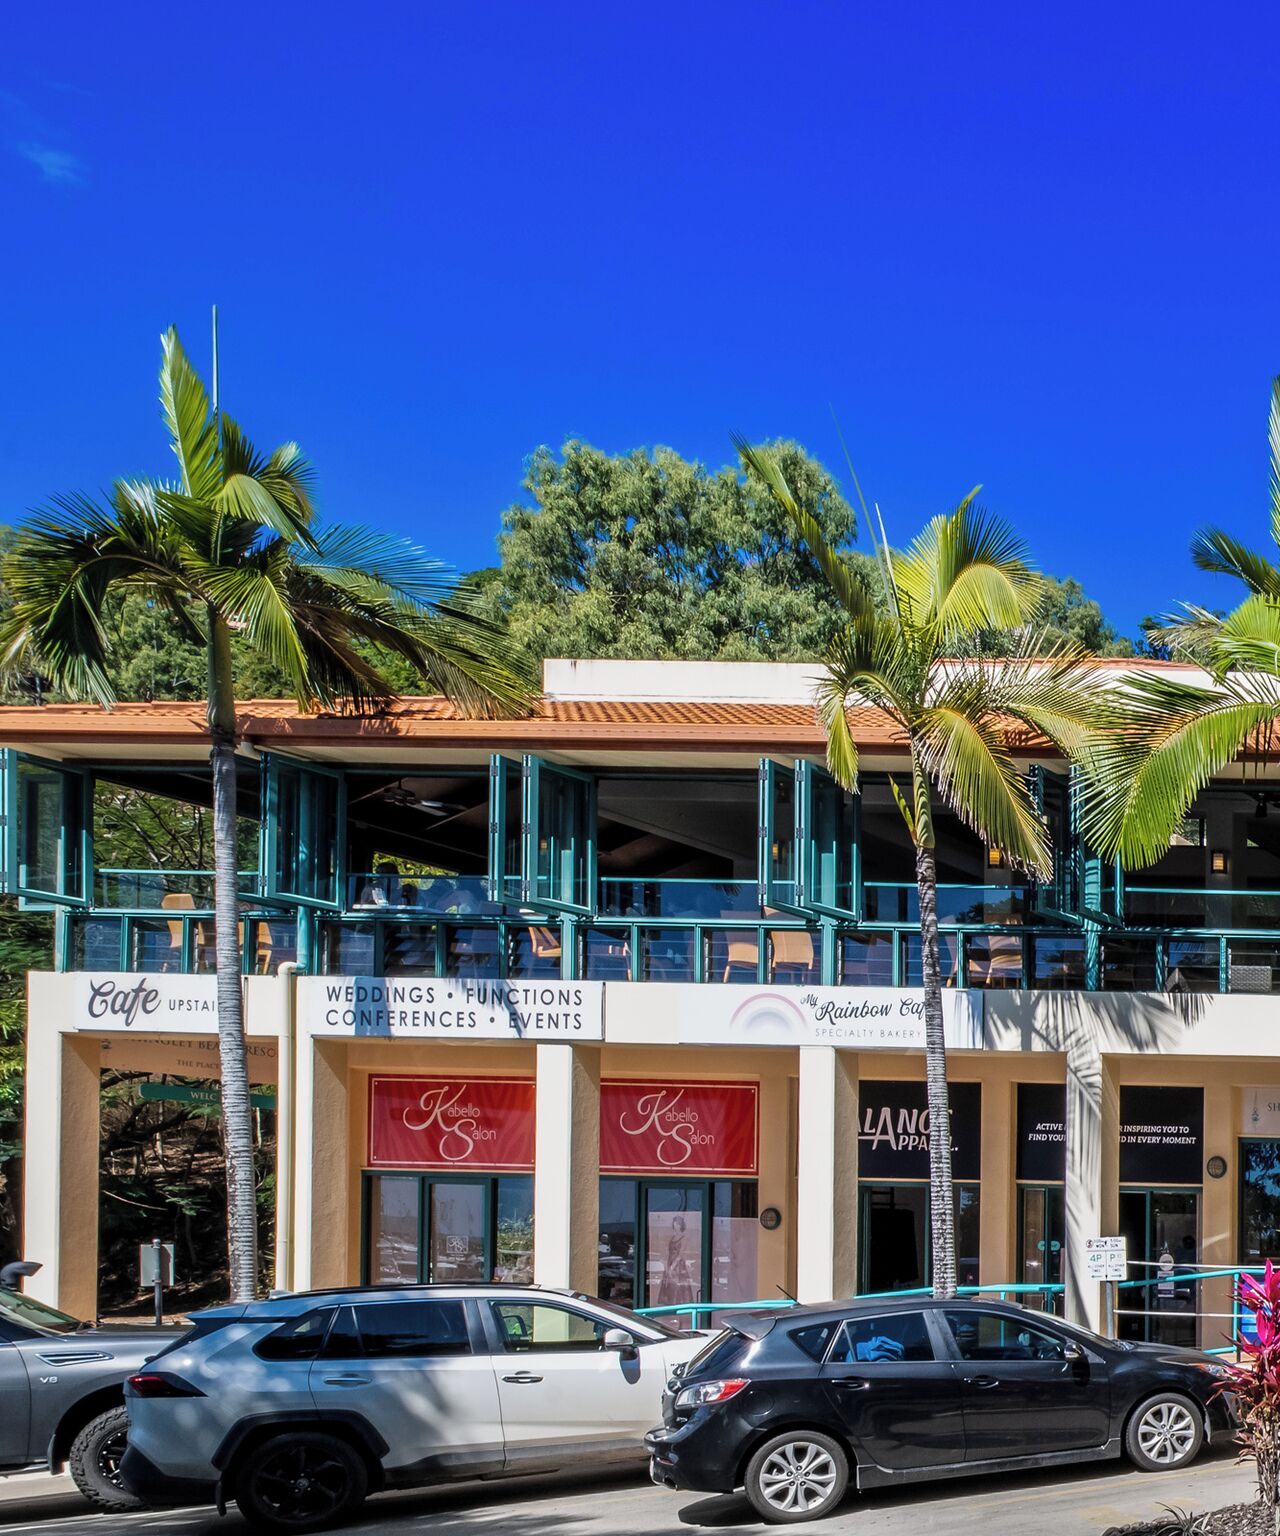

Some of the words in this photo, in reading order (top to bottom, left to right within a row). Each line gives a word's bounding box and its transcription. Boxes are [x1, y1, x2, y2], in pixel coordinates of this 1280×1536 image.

[168, 998, 216, 1012] UPSTAI
[326, 986, 435, 1004] WEDDINGS
[466, 988, 583, 1006] FUNCTIONS
[326, 1009, 477, 1028] CONFERENCES
[508, 1012, 583, 1030] EVENTS
[800, 993, 818, 1009] My
[814, 1000, 892, 1026] Rainbow
[899, 997, 926, 1020] Caf
[815, 1028, 874, 1038] SPECIALTY
[880, 1029, 921, 1039] BAKERY
[190, 1091, 218, 1101] WELC
[403, 1084, 480, 1132] Kabello
[620, 1089, 699, 1136] Kabello
[1036, 1123, 1063, 1131] ACTIVE
[1124, 1125, 1162, 1133] INSPIRING
[1163, 1126, 1177, 1134] YOU
[439, 1118, 496, 1160] Salon
[656, 1123, 715, 1166] Salon
[1137, 1136, 1160, 1144] EVERY
